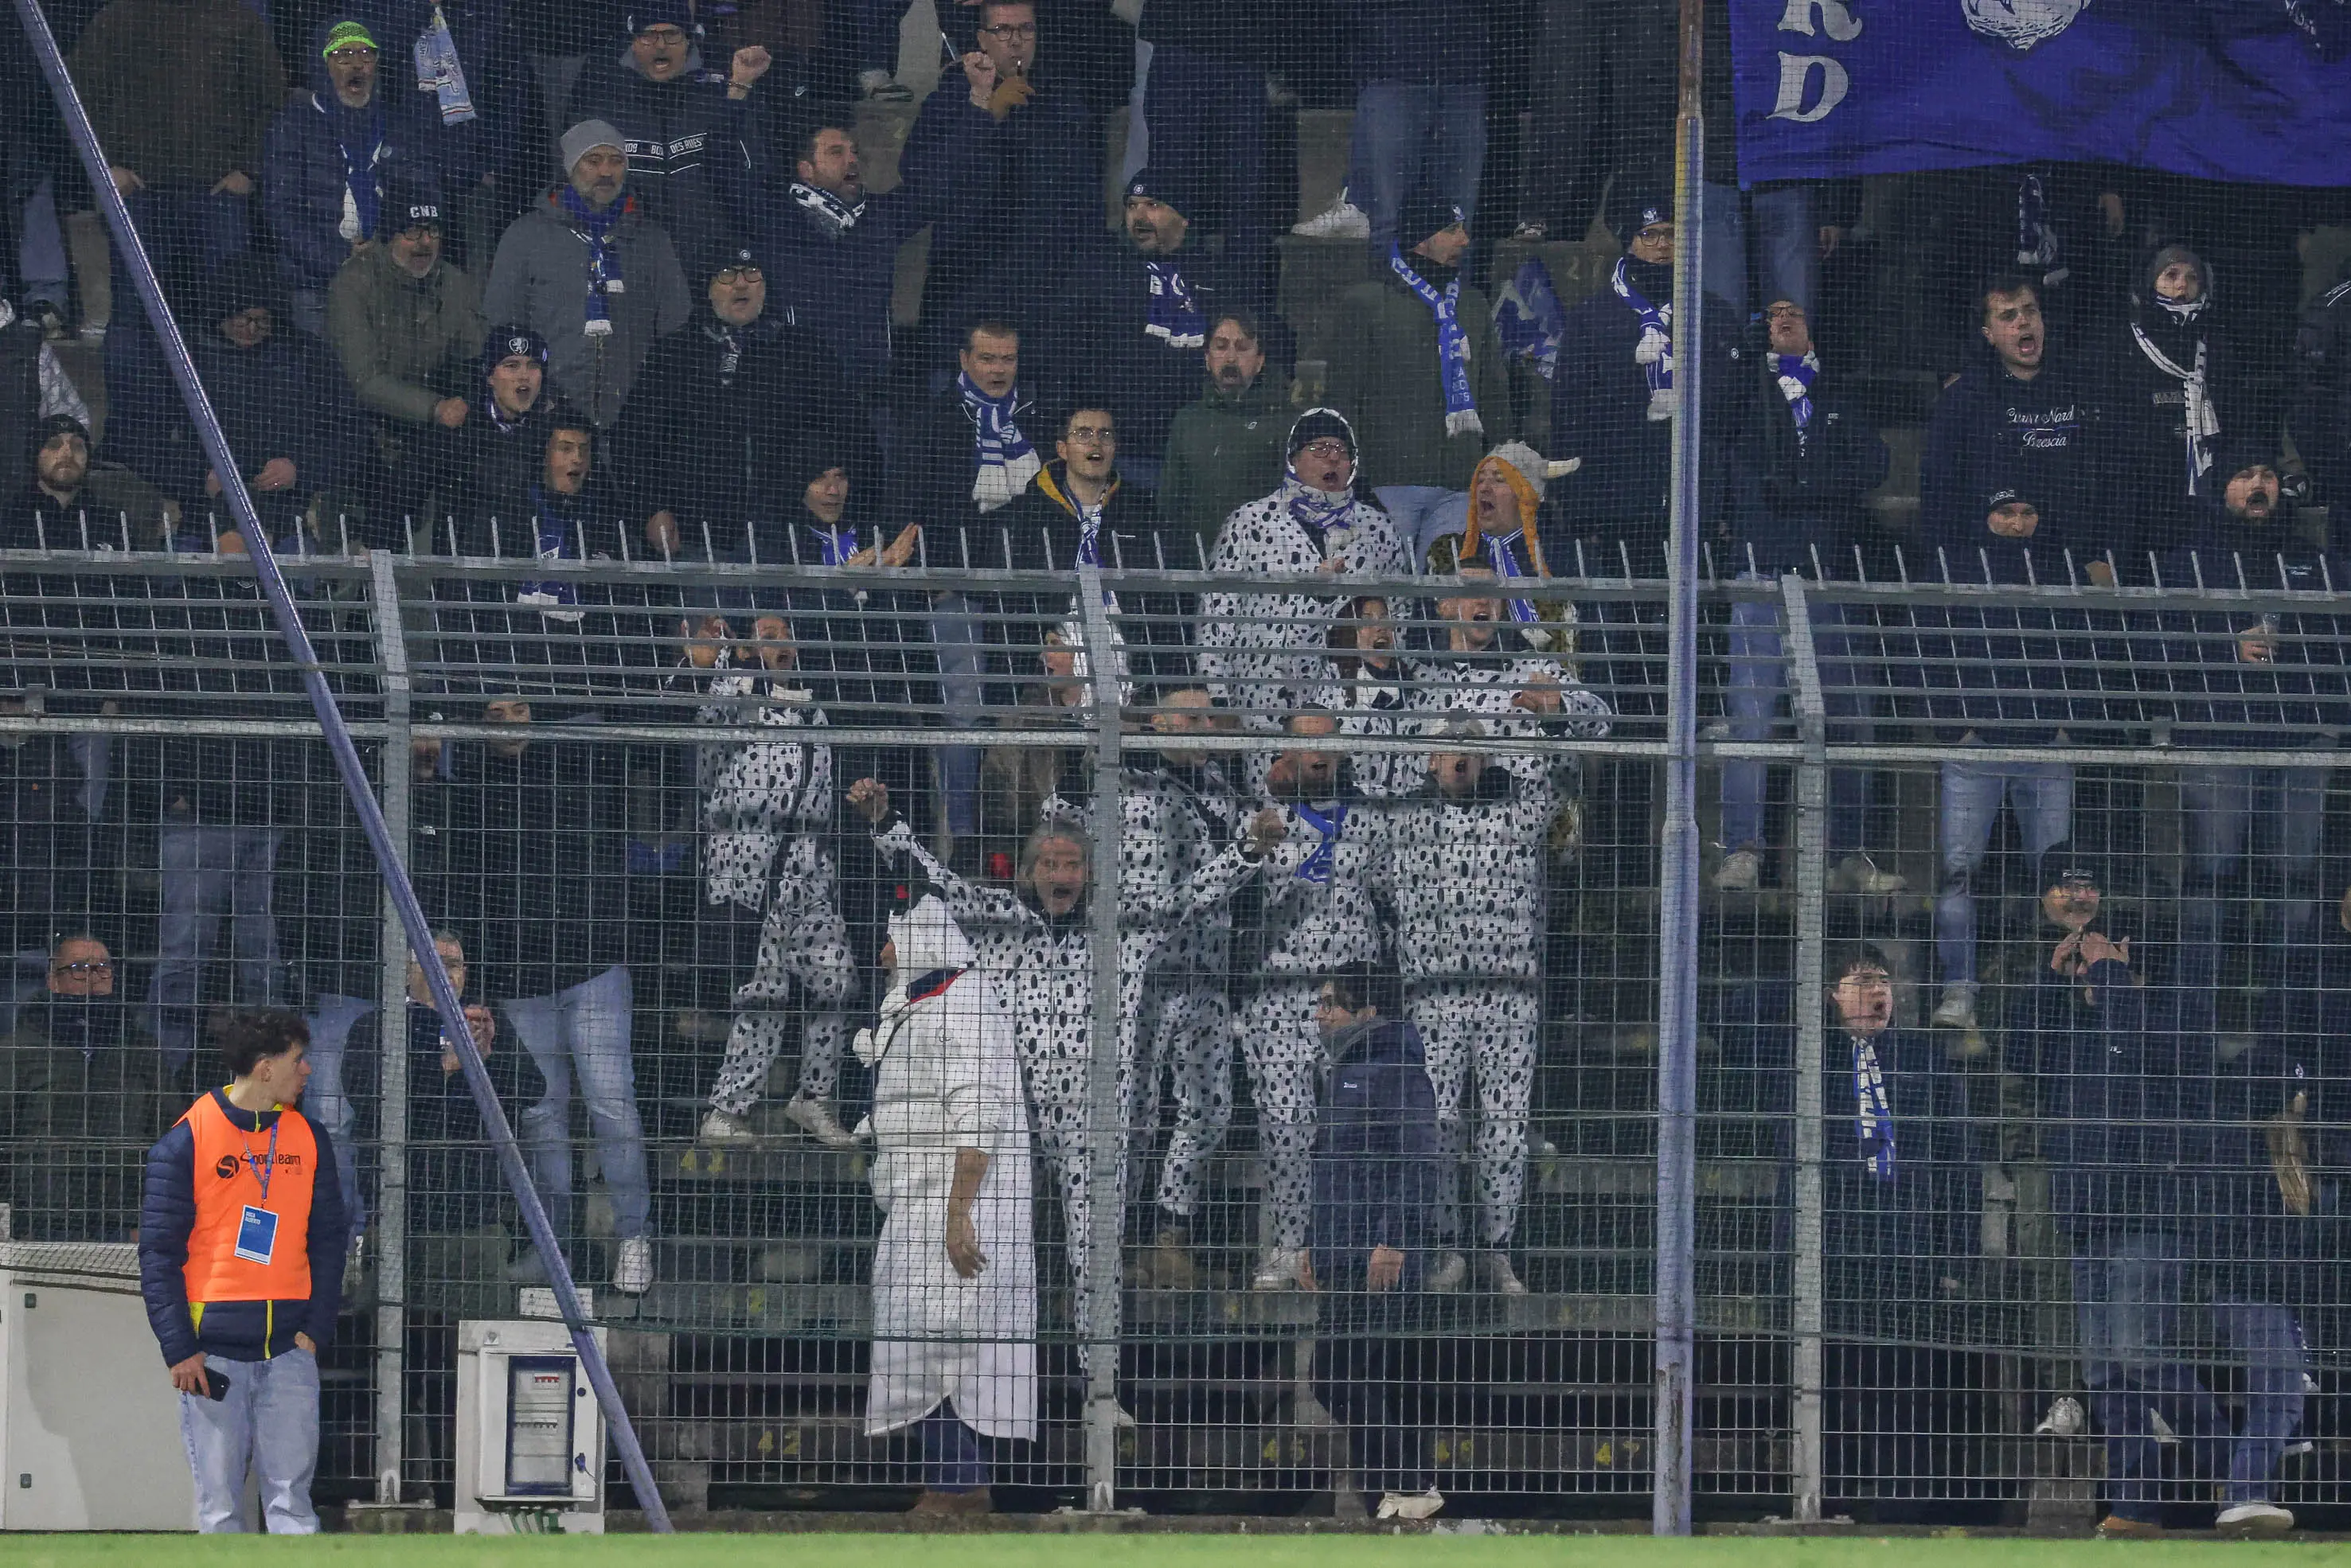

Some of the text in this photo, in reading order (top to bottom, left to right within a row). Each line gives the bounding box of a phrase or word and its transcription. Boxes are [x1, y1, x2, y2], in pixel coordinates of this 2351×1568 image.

[670, 142, 685, 154] DES
[410, 205, 439, 218] CNB
[2022, 431, 2068, 448] Brescia
